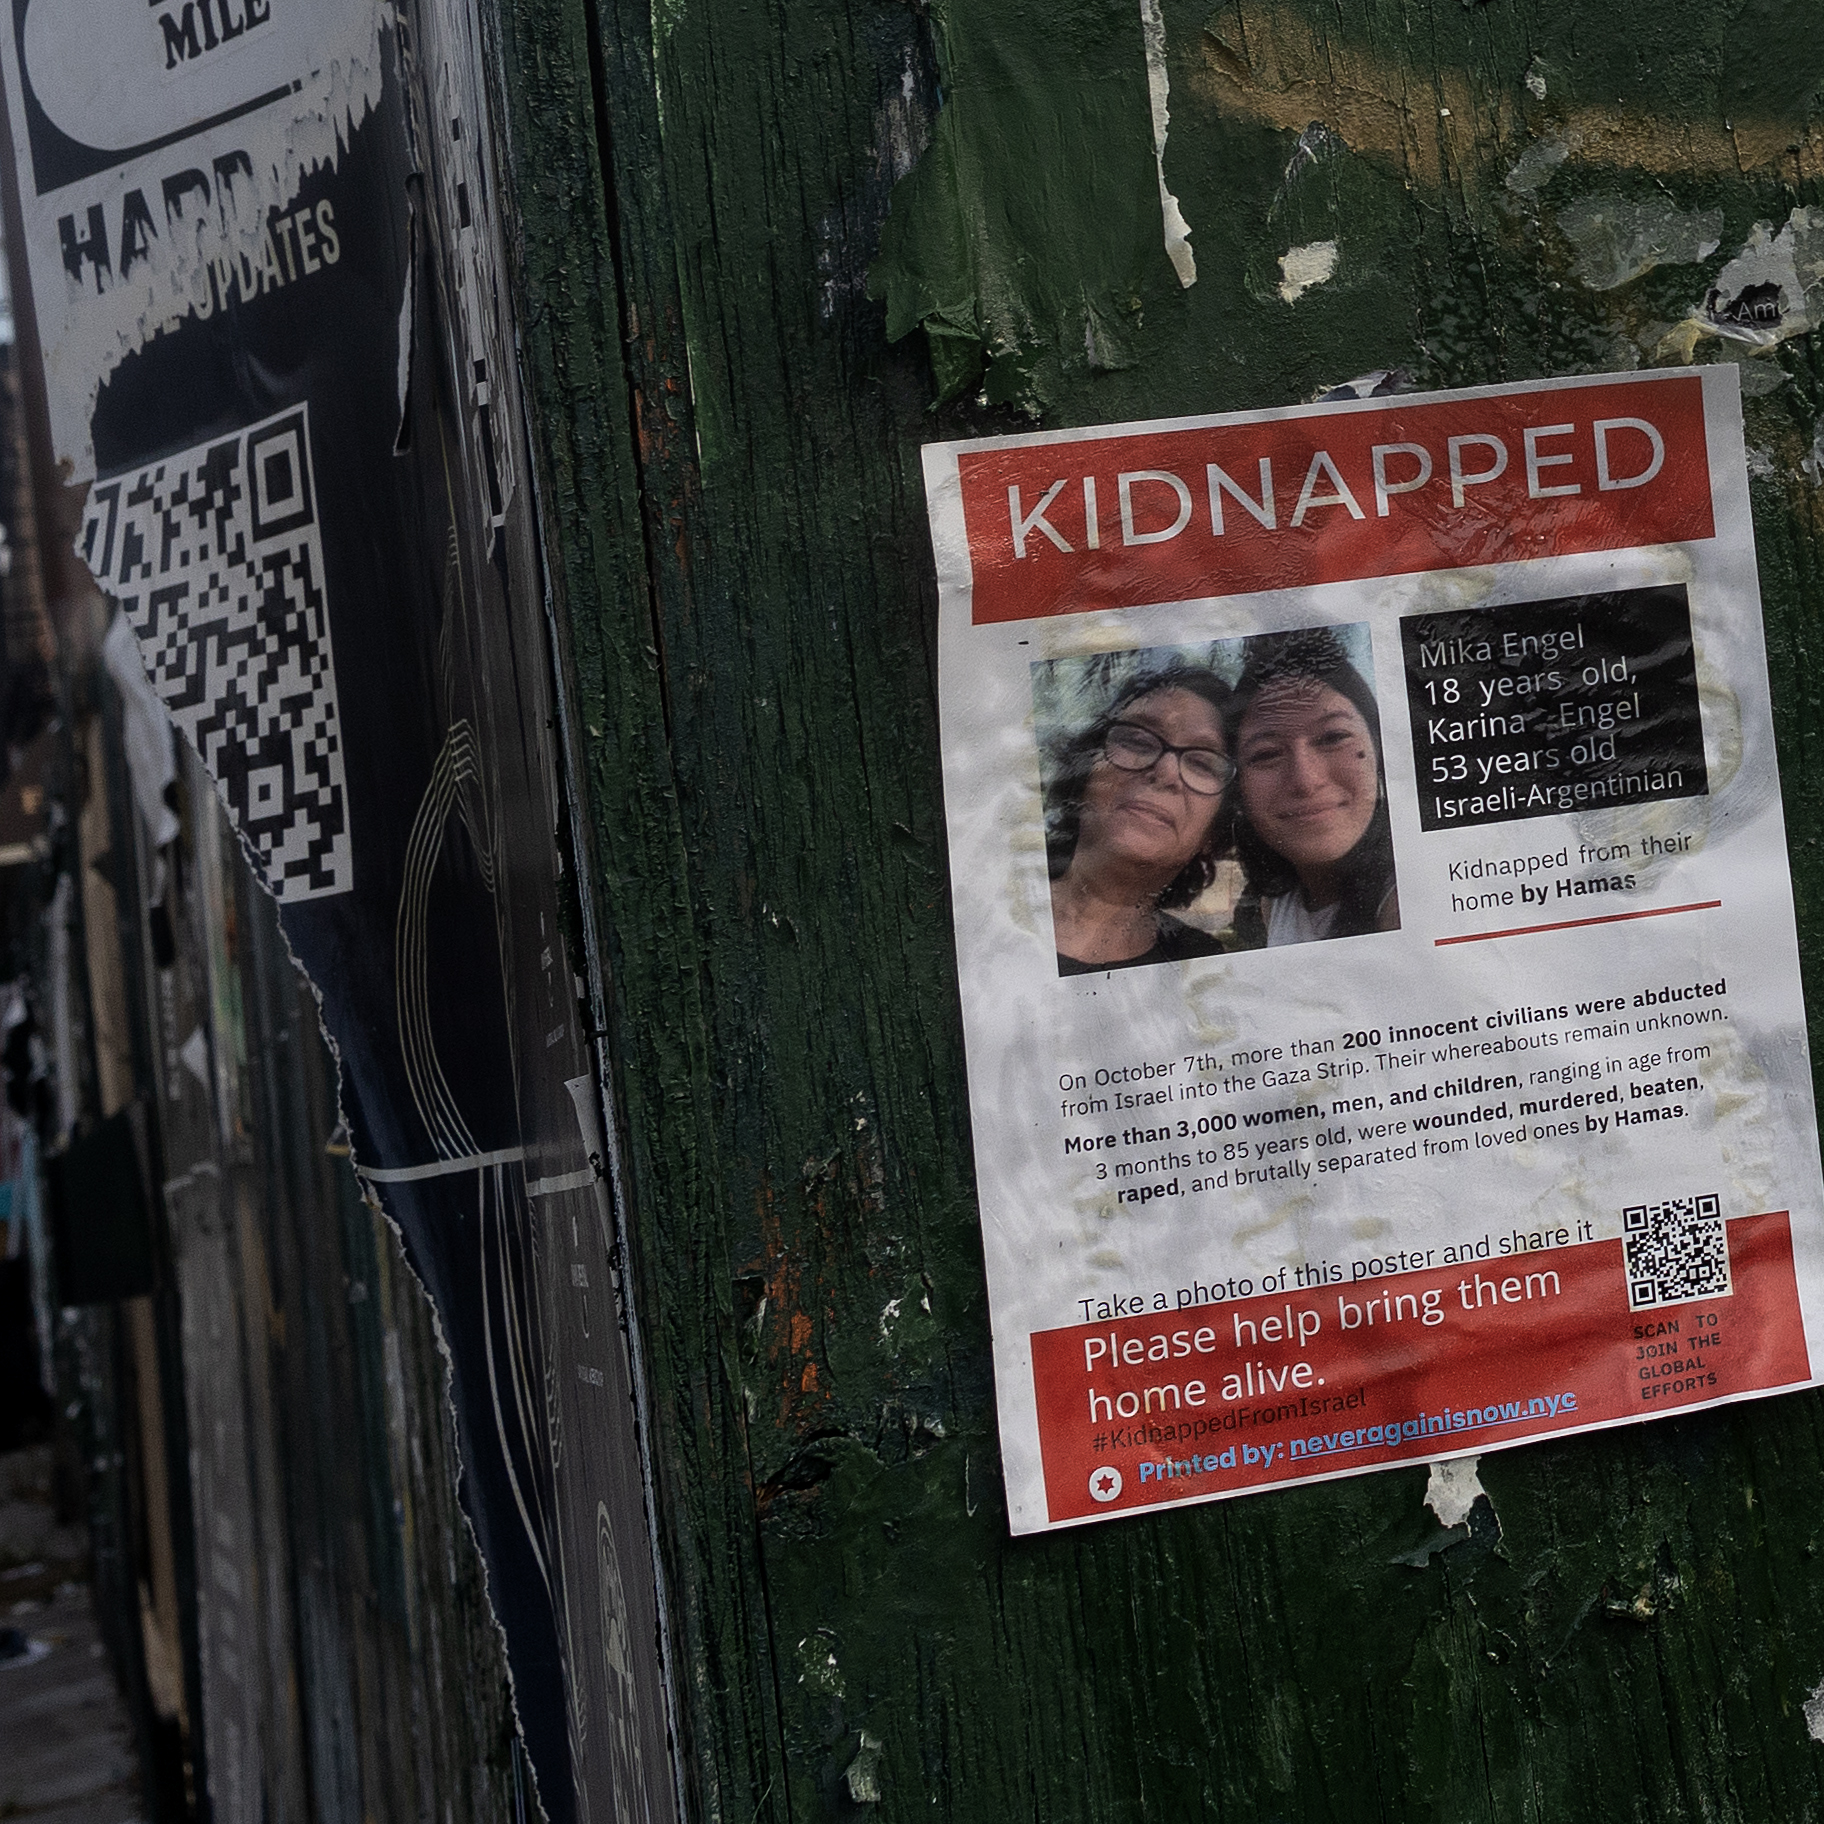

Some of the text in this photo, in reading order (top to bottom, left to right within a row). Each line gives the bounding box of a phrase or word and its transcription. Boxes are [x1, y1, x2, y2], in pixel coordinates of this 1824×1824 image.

[1008, 416, 1667, 560] KIDNAPPED
[1419, 624, 1586, 668] Mika Engel
[1428, 693, 1642, 743] Karina Engel
[1432, 764, 1684, 820] Israeli-Argentinian
[1083, 1264, 1563, 1373] Please help bring them
[1088, 1354, 1327, 1425] home alive.
[1136, 1388, 1579, 1485] Printed by: neveragainisnow.nyc
